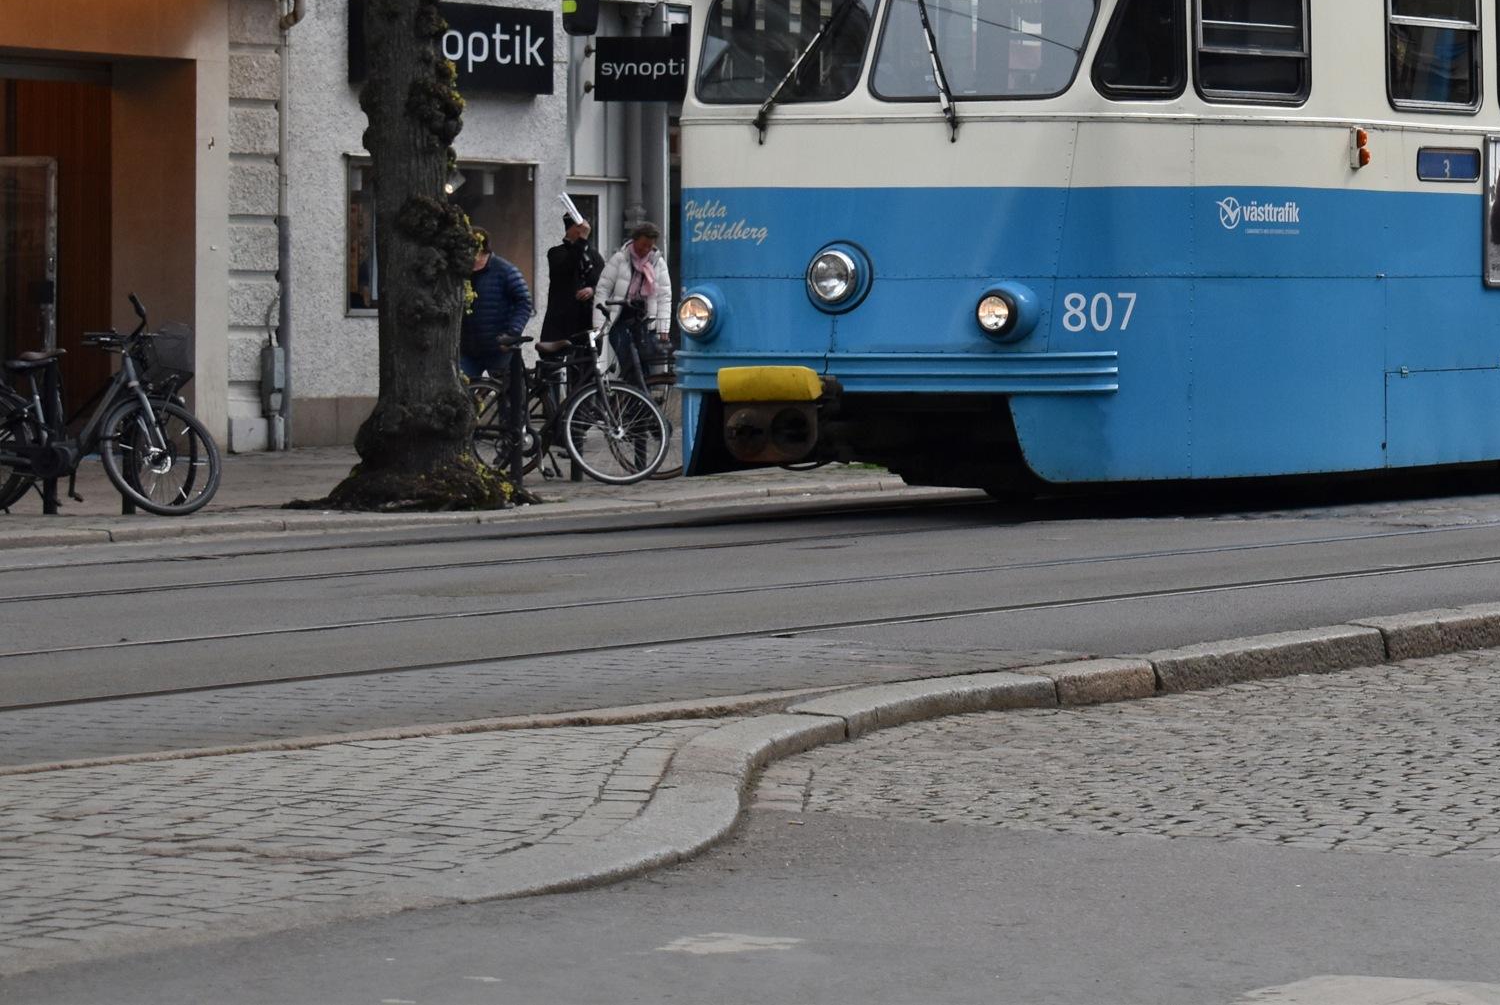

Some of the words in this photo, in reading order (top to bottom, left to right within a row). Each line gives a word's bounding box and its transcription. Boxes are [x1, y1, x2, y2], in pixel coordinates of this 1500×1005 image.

[441, 23, 545, 73] optik
[601, 58, 685, 80] synopti
[685, 200, 727, 221] Hulda
[1243, 201, 1300, 223] västtrafik
[692, 219, 768, 245] Sköldberg
[1062, 292, 1137, 332] 807
